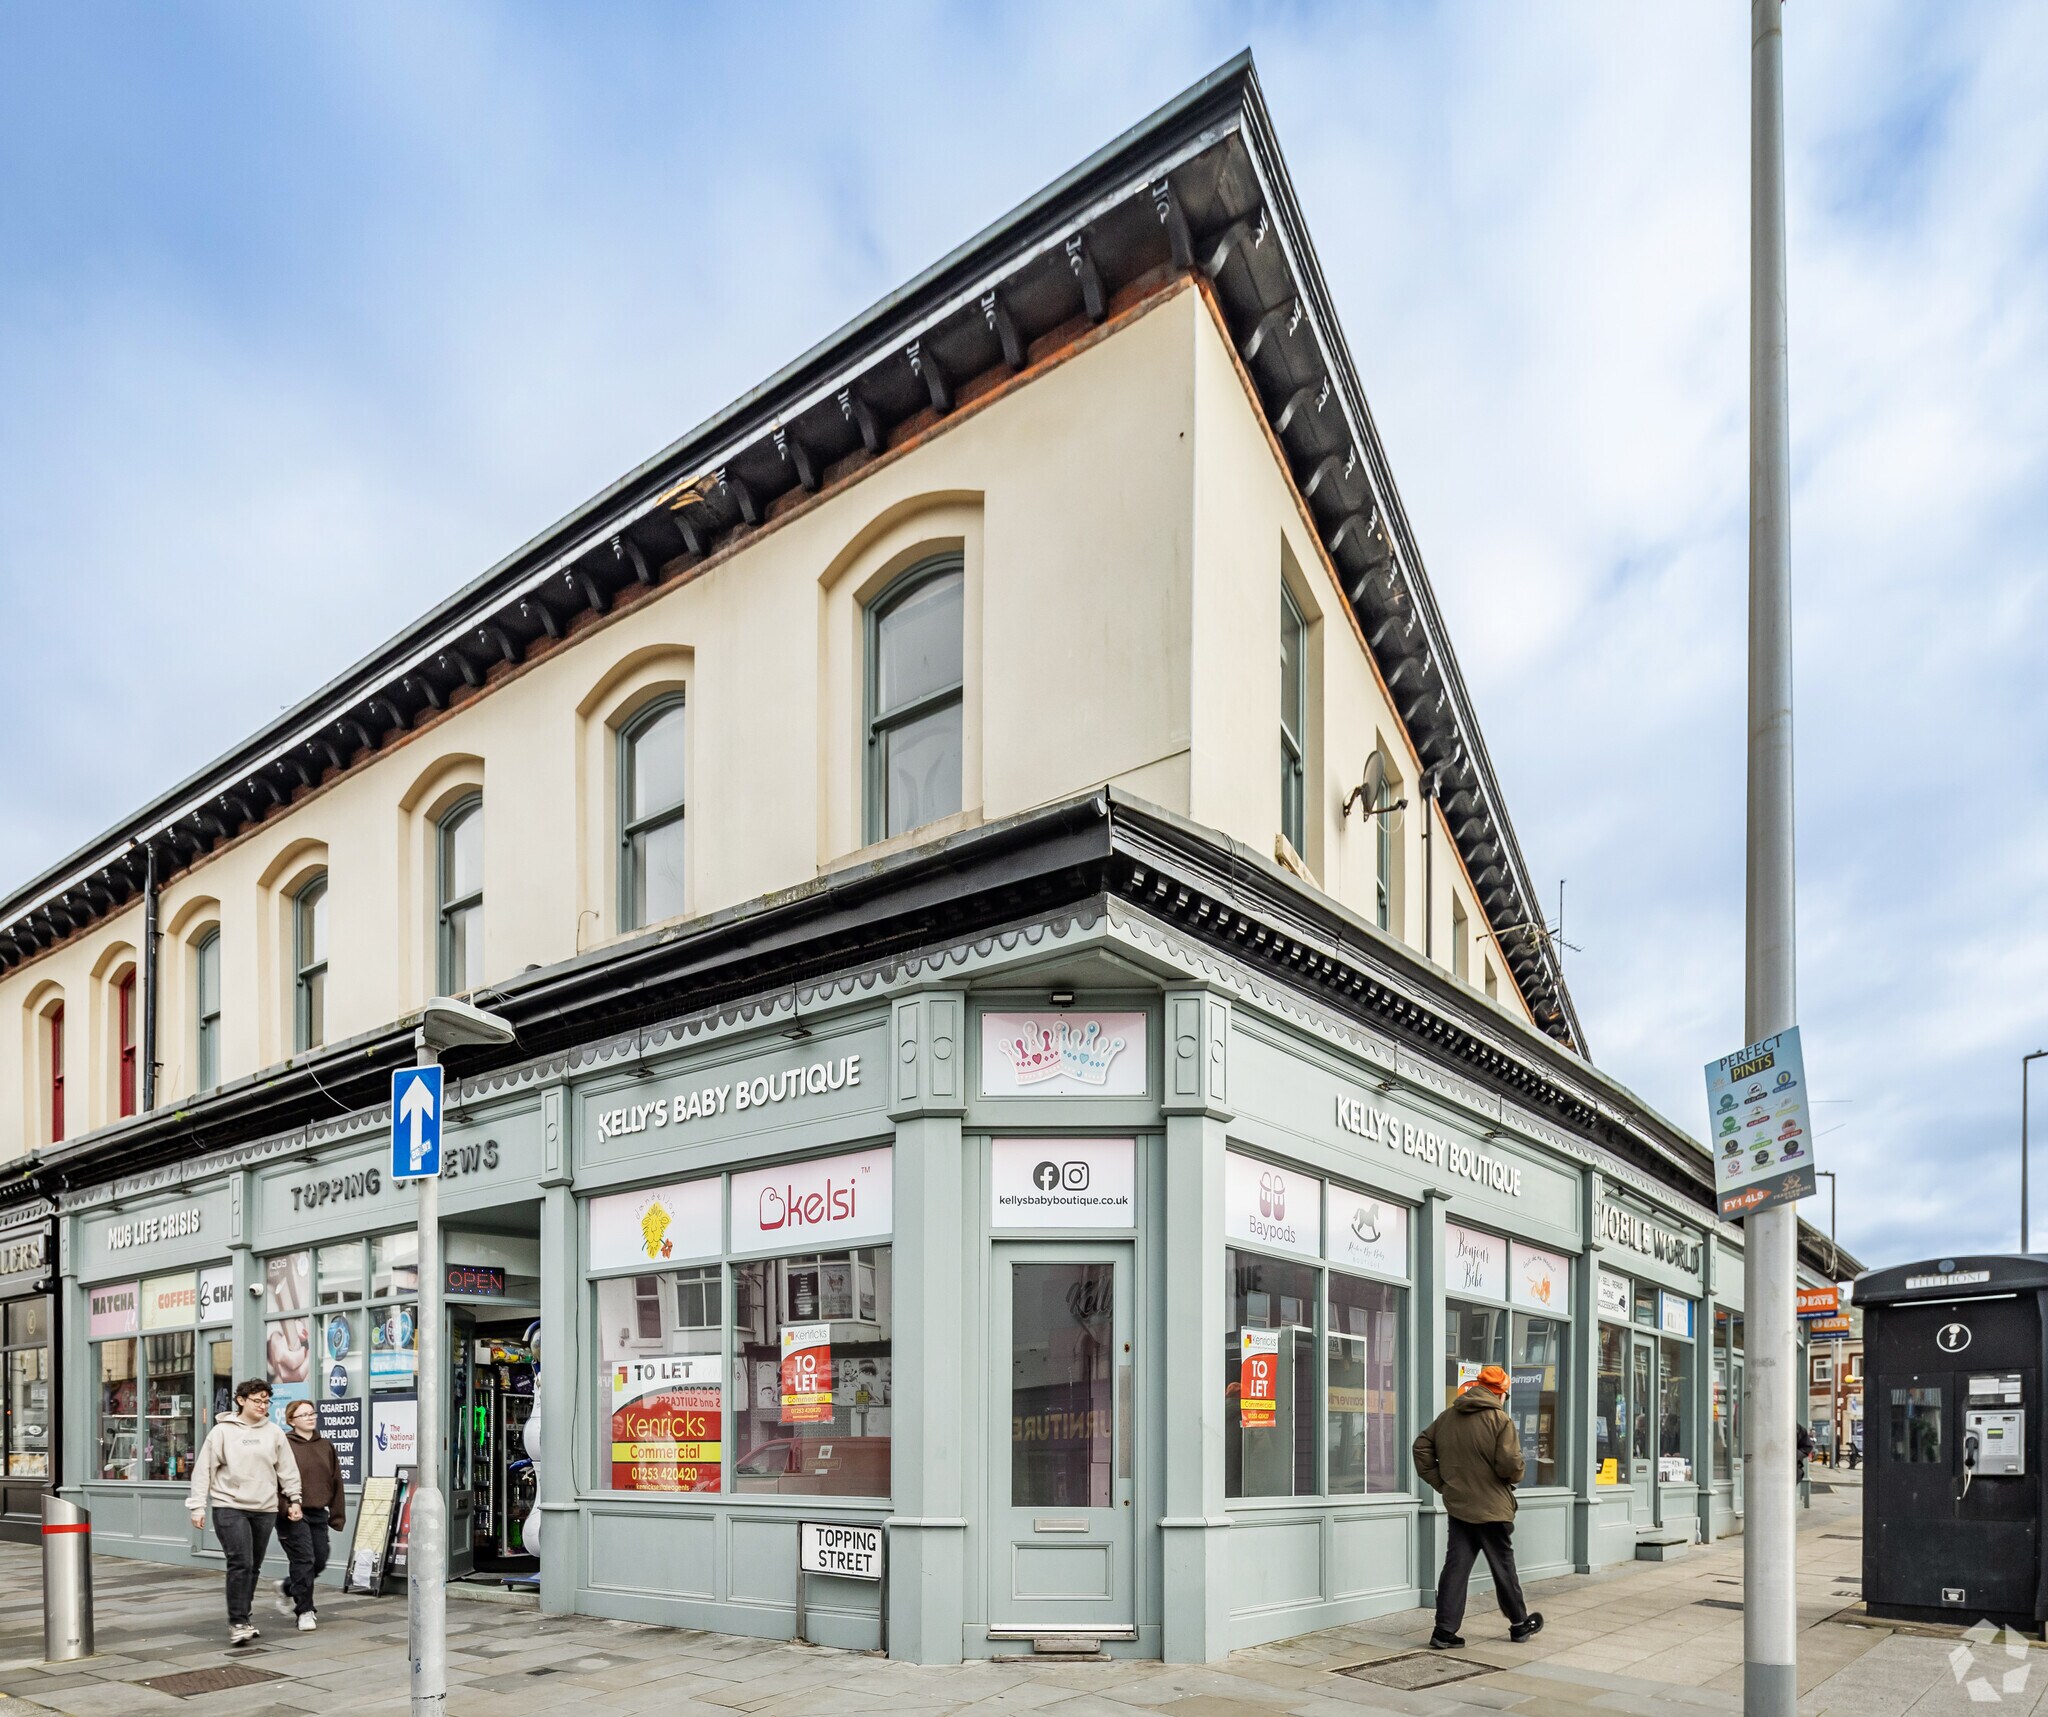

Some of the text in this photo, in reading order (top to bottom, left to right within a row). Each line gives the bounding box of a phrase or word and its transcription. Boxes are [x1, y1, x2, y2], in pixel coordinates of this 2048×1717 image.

[1720, 1033, 1782, 1071] PERFECT
[1733, 1054, 1772, 1080] PINTS
[598, 1054, 861, 1143] KELLY'S BABY BOUTIQUE
[1336, 1093, 1521, 1197] KELLY'S BABY BOUTIQUE
[291, 1167, 381, 1211] TOPPING
[999, 1196, 1128, 1206] kellysbabyboutique.co.uk
[1724, 1195, 1742, 1210] FY1
[1745, 1191, 1764, 1205] 4LS
[108, 1207, 201, 1251] MUG LIFE CRISIS
[1249, 1215, 1296, 1244] Baypods
[0, 1241, 41, 1274] LERS
[1456, 1229, 1489, 1267] Bonjour
[1653, 1228, 1700, 1275] WORLD
[448, 1271, 502, 1289] OPEN
[158, 1288, 197, 1310] COFFEE
[213, 1284, 233, 1303] CHA
[92, 1292, 134, 1315] MATCHA
[795, 1329, 827, 1341] Kenricks
[1252, 1334, 1276, 1347] Kenricks
[634, 1361, 693, 1381] TO LET
[795, 1354, 816, 1373] TO
[1252, 1360, 1268, 1378] TO
[330, 1375, 347, 1387] zone
[795, 1373, 818, 1392] LET
[1250, 1379, 1268, 1397] LET
[320, 1402, 359, 1413] CIGARETTES
[788, 1394, 826, 1403] Commercial
[324, 1416, 355, 1426] TOBACCO
[390, 1424, 401, 1432] The
[626, 1411, 706, 1438] Kenricks
[320, 1429, 359, 1439] VAPE LIQUID
[390, 1433, 415, 1442] National
[333, 1442, 354, 1452] TTERY
[390, 1442, 412, 1451] Lottery
[630, 1444, 700, 1459] Commercial
[338, 1456, 354, 1466] ONE
[631, 1467, 697, 1480] 01253 420420
[816, 1527, 876, 1551] TOPPING
[818, 1549, 872, 1573] STREET
